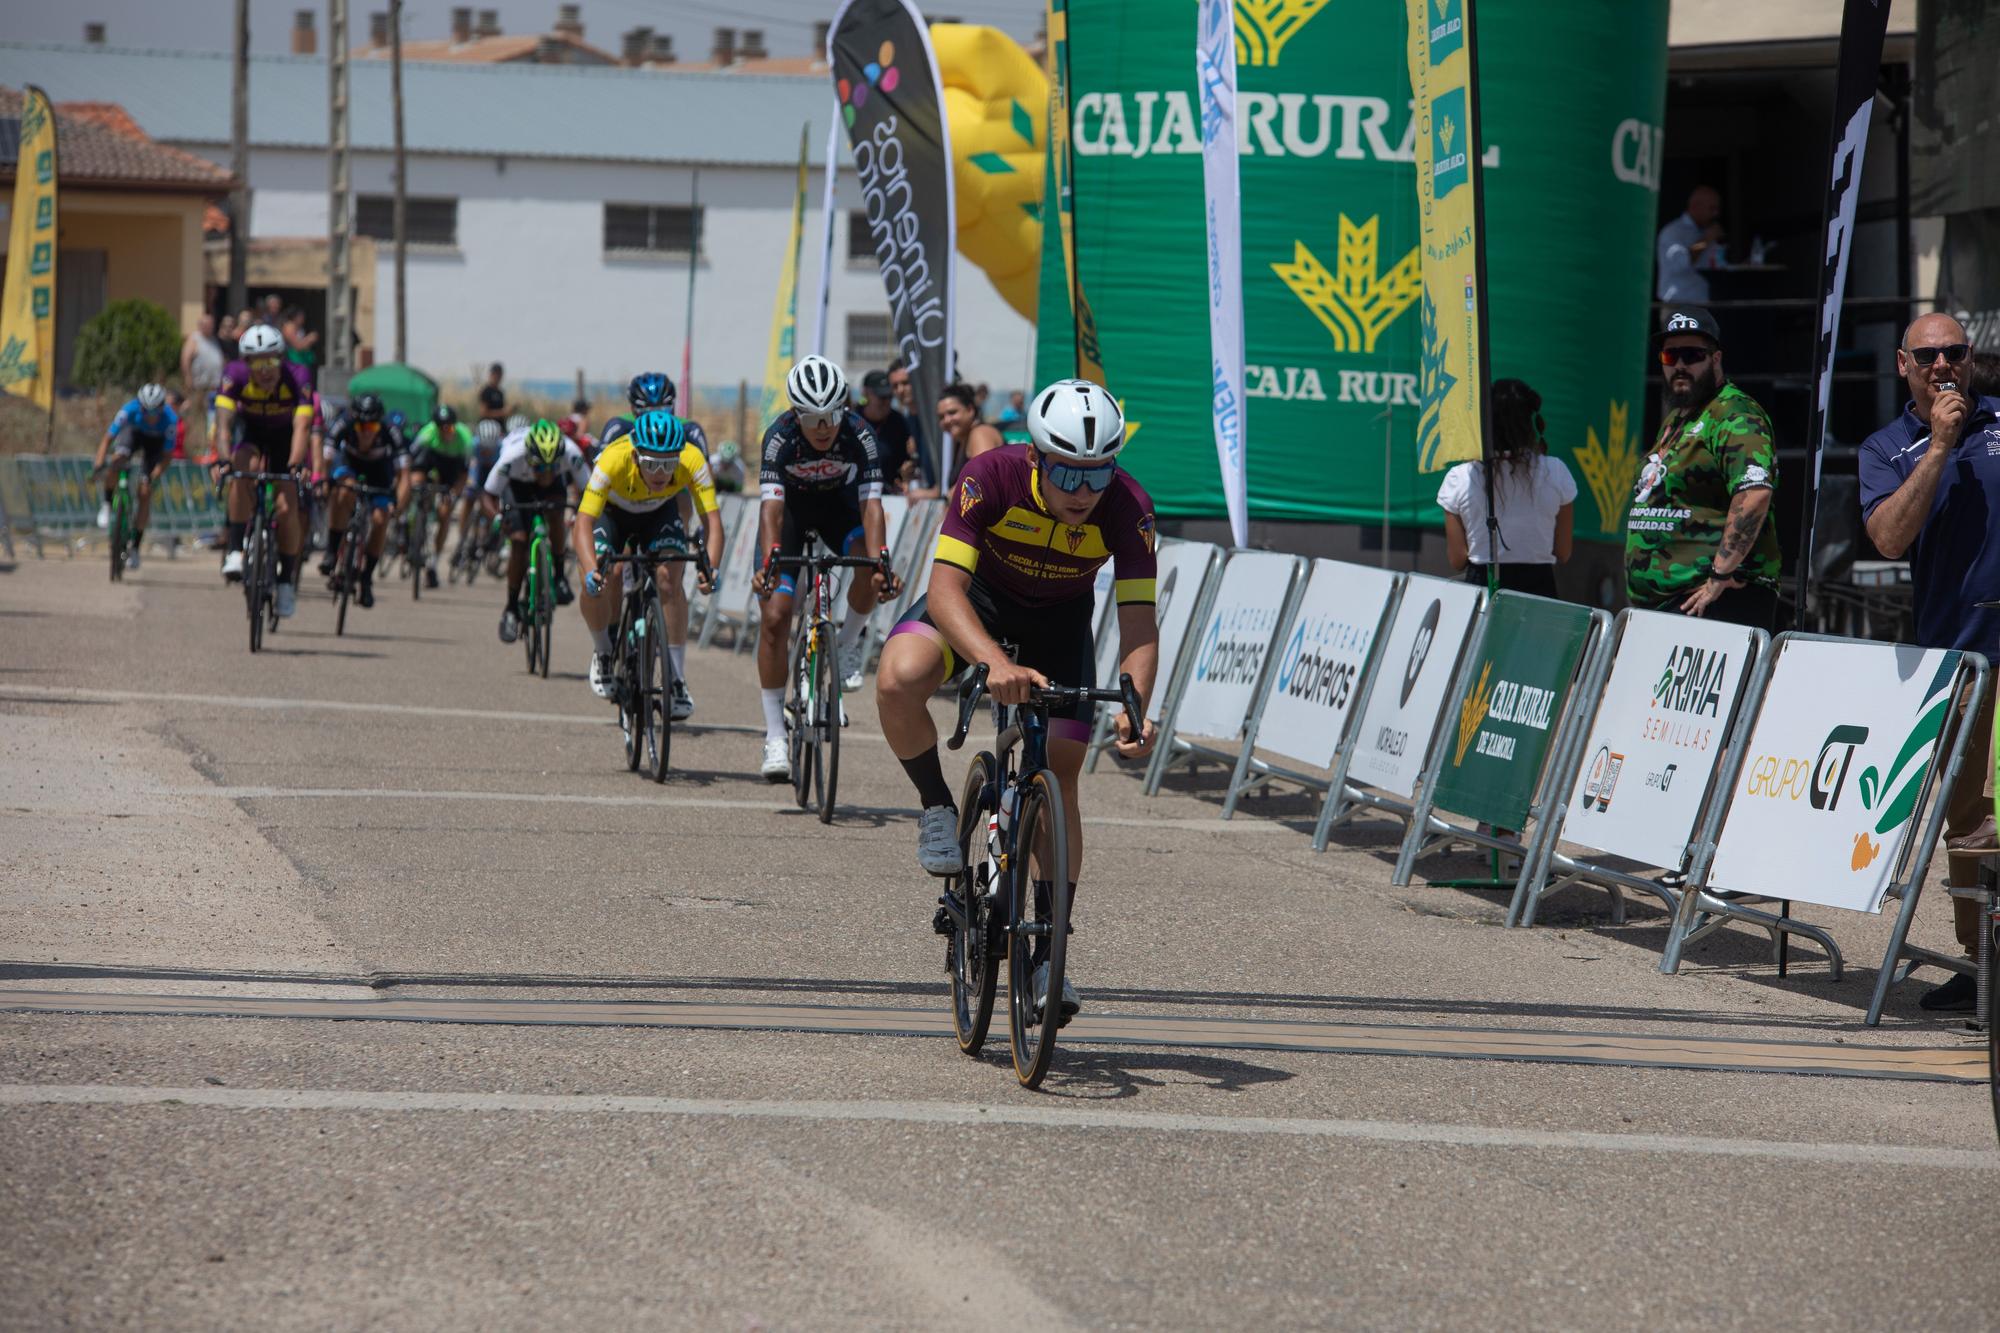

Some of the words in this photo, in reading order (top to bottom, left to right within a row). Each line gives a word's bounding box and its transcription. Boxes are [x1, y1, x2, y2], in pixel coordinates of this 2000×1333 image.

[1073, 91, 1204, 158] CAJA
[1237, 93, 1499, 168] RUR
[1244, 364, 1327, 401] CAJA
[1337, 370, 1420, 406] RUR
[1629, 507, 1693, 519] PORTIVAS
[1289, 646, 1355, 711] cobreros
[1662, 645, 1728, 718] ARIMA
[1514, 683, 1556, 730] RURAL
[1475, 731, 1489, 753] DE
[1485, 732, 1517, 761] ZAMORA
[1642, 717, 1711, 751] SEMILLAS
[1747, 755, 1811, 801] GRUPO
